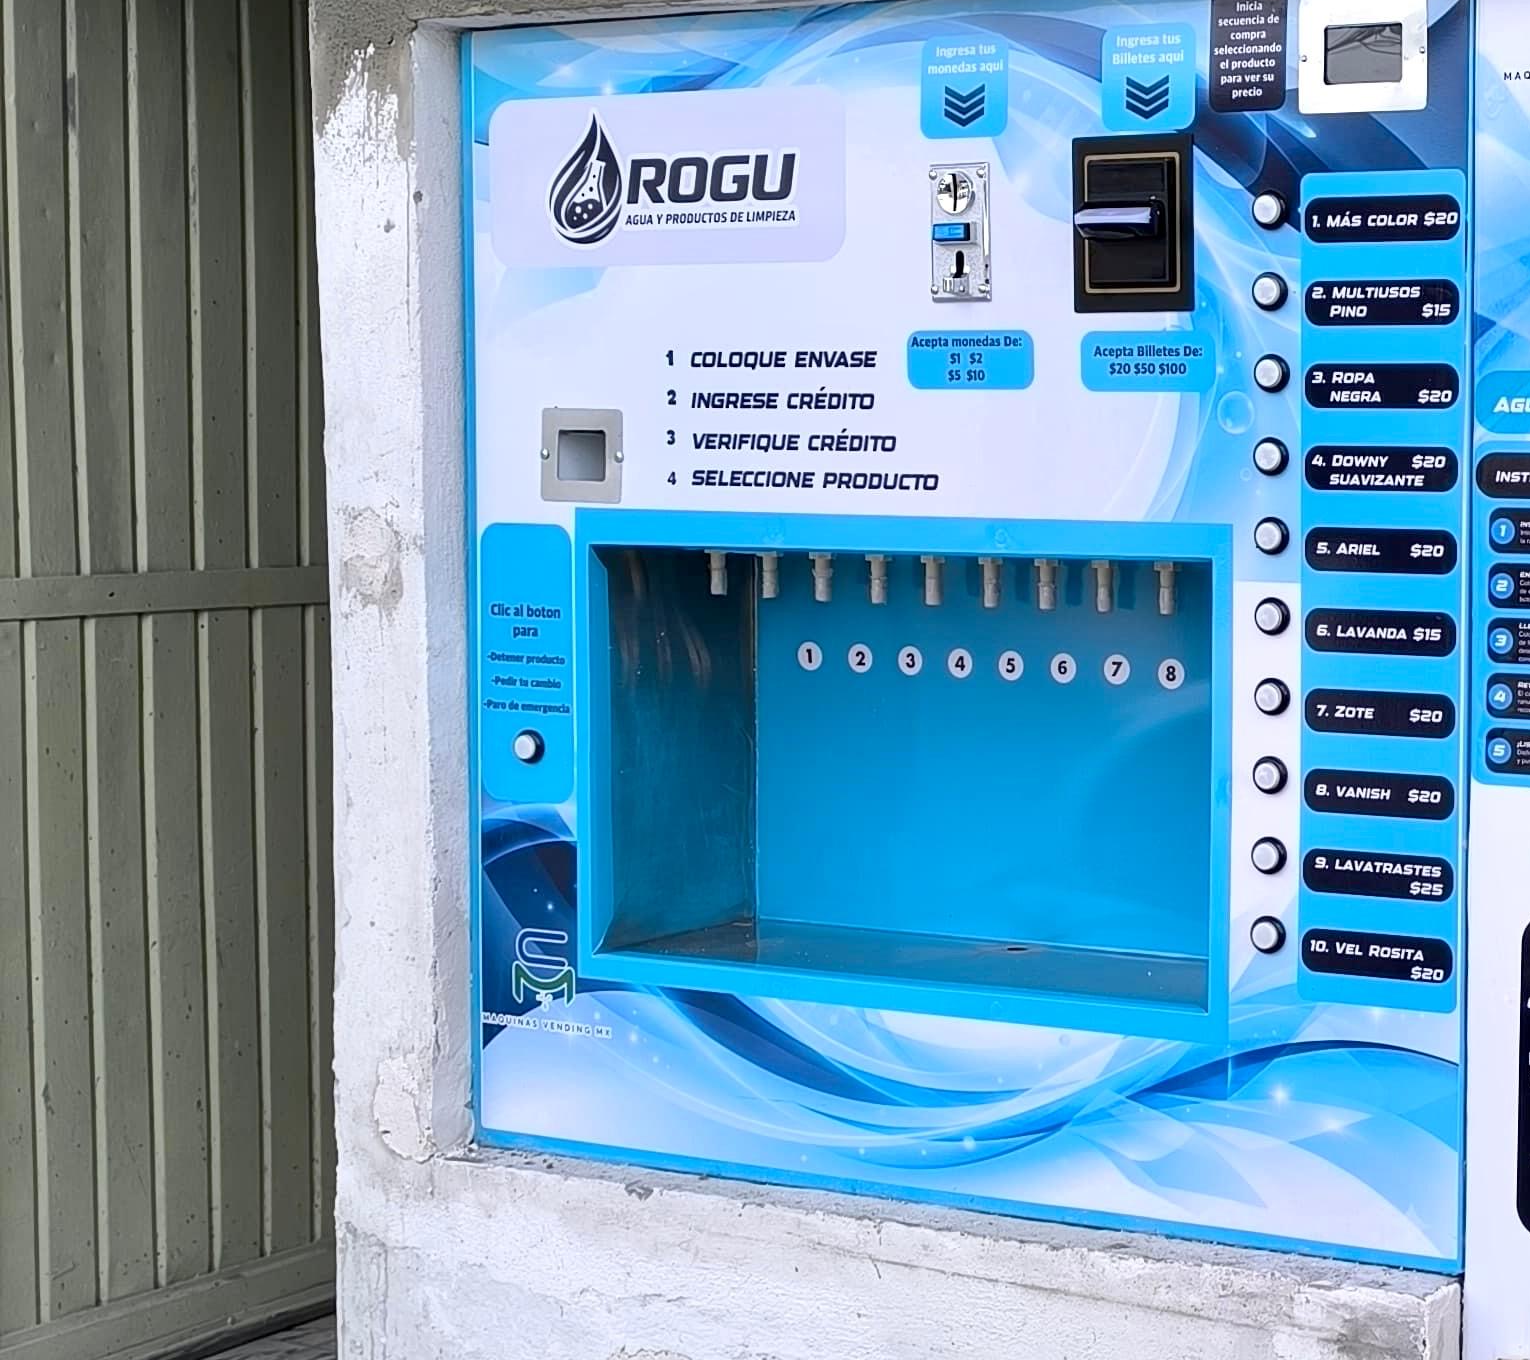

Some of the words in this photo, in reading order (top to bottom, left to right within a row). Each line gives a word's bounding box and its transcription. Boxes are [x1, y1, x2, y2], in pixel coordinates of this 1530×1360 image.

[1236, 1, 1263, 12] Inicia
[1218, 15, 1265, 26] secuencia
[1267, 14, 1280, 24] de
[1116, 35, 1160, 49] Ingresa
[1162, 33, 1182, 45] tus
[1230, 30, 1266, 40] compra
[935, 45, 976, 59] Ingresa
[979, 44, 997, 55] tus
[1214, 42, 1282, 55] seleccionando
[1112, 51, 1156, 65] Billetes
[1220, 59, 1229, 69] el
[1231, 58, 1276, 70] producto
[927, 60, 977, 75] monedas
[1220, 74, 1242, 85] para
[1244, 74, 1260, 82] ver
[1262, 73, 1274, 81] su
[1232, 87, 1263, 99] precio
[626, 153, 796, 204] ROGU
[625, 214, 653, 226] AGUA
[657, 213, 664, 225] Y
[665, 212, 727, 224] PRODUCTOS
[730, 211, 745, 223] DE
[746, 210, 796, 222] LIMPIEZA
[1312, 215, 1321, 228] 1.
[1326, 210, 1362, 228] MÁS
[1367, 214, 1418, 227] COLOR
[1423, 211, 1458, 227] $20
[1311, 287, 1326, 299] 2.
[1331, 286, 1421, 299] MULTIUSOS
[1329, 305, 1368, 318] PINO
[1421, 303, 1451, 318] $15
[911, 336, 949, 349] Acepta
[951, 336, 1001, 347] monedas
[1004, 336, 1022, 347] De:
[950, 353, 961, 365] $1
[969, 352, 983, 365] $2
[1094, 346, 1134, 359] Acepta
[1137, 345, 1180, 357] Billetes
[1183, 346, 1203, 357] De:
[665, 350, 674, 366] 1
[690, 351, 787, 370] COLOQUE
[794, 351, 877, 368] ENVASE
[948, 369, 961, 382] $5
[966, 369, 985, 382] $10
[1109, 363, 1131, 375] $20
[1134, 363, 1155, 375] $50
[1158, 362, 1187, 375] $100
[1311, 371, 1326, 384] 3.
[1331, 371, 1375, 384] ROPA
[667, 389, 677, 405] 2
[691, 392, 779, 409] INGRESE
[786, 386, 875, 410] CRÉDITO
[1329, 390, 1382, 403] NEGRA
[1418, 389, 1452, 404] $20
[666, 429, 676, 445] 3
[692, 433, 800, 453] VERIFIQUE
[807, 428, 897, 452] CRÉDITO
[1311, 454, 1326, 467] 4.
[1331, 455, 1389, 468] DOWNY
[1412, 454, 1446, 469] $20
[667, 471, 677, 485] 4
[691, 470, 815, 489] SELECCIONE
[822, 472, 939, 491] PRODUCTO
[1329, 474, 1425, 487] SUAVIZANTE
[1316, 542, 1331, 554] 5.
[1336, 543, 1381, 556] ARIEL
[1410, 543, 1444, 558] $20
[490, 603, 511, 616] Clic
[513, 604, 524, 617] al
[526, 604, 561, 619] boton
[512, 626, 538, 638] para
[1316, 624, 1331, 636] 6.
[1336, 625, 1407, 640] LAVANDA
[1412, 627, 1442, 642] $15
[806, 649, 813, 664] 1
[855, 650, 866, 666] 2
[906, 653, 916, 669] 3
[954, 655, 966, 671] 4
[1006, 658, 1016, 673] 5
[1057, 660, 1067, 676] 6
[1111, 661, 1123, 677] 7
[1165, 666, 1176, 682] 8
[1316, 704, 1329, 717] 7.
[1334, 705, 1375, 719] ZOTE
[1409, 708, 1443, 723] $20
[1315, 784, 1330, 797] 8.
[1336, 786, 1391, 800] VANISH
[1407, 789, 1441, 804] $20
[1314, 856, 1329, 869] 9.
[1334, 858, 1442, 878] LAVATRASTES
[1409, 881, 1444, 896] $25
[1310, 939, 1329, 953] 10.
[1335, 942, 1363, 956] VEL
[1368, 944, 1424, 961] ROSITA
[1410, 966, 1444, 981] $20
[483, 1014, 537, 1028] MAQUINAS
[543, 1021, 590, 1035] VENDING
[596, 1028, 610, 1036] MX
